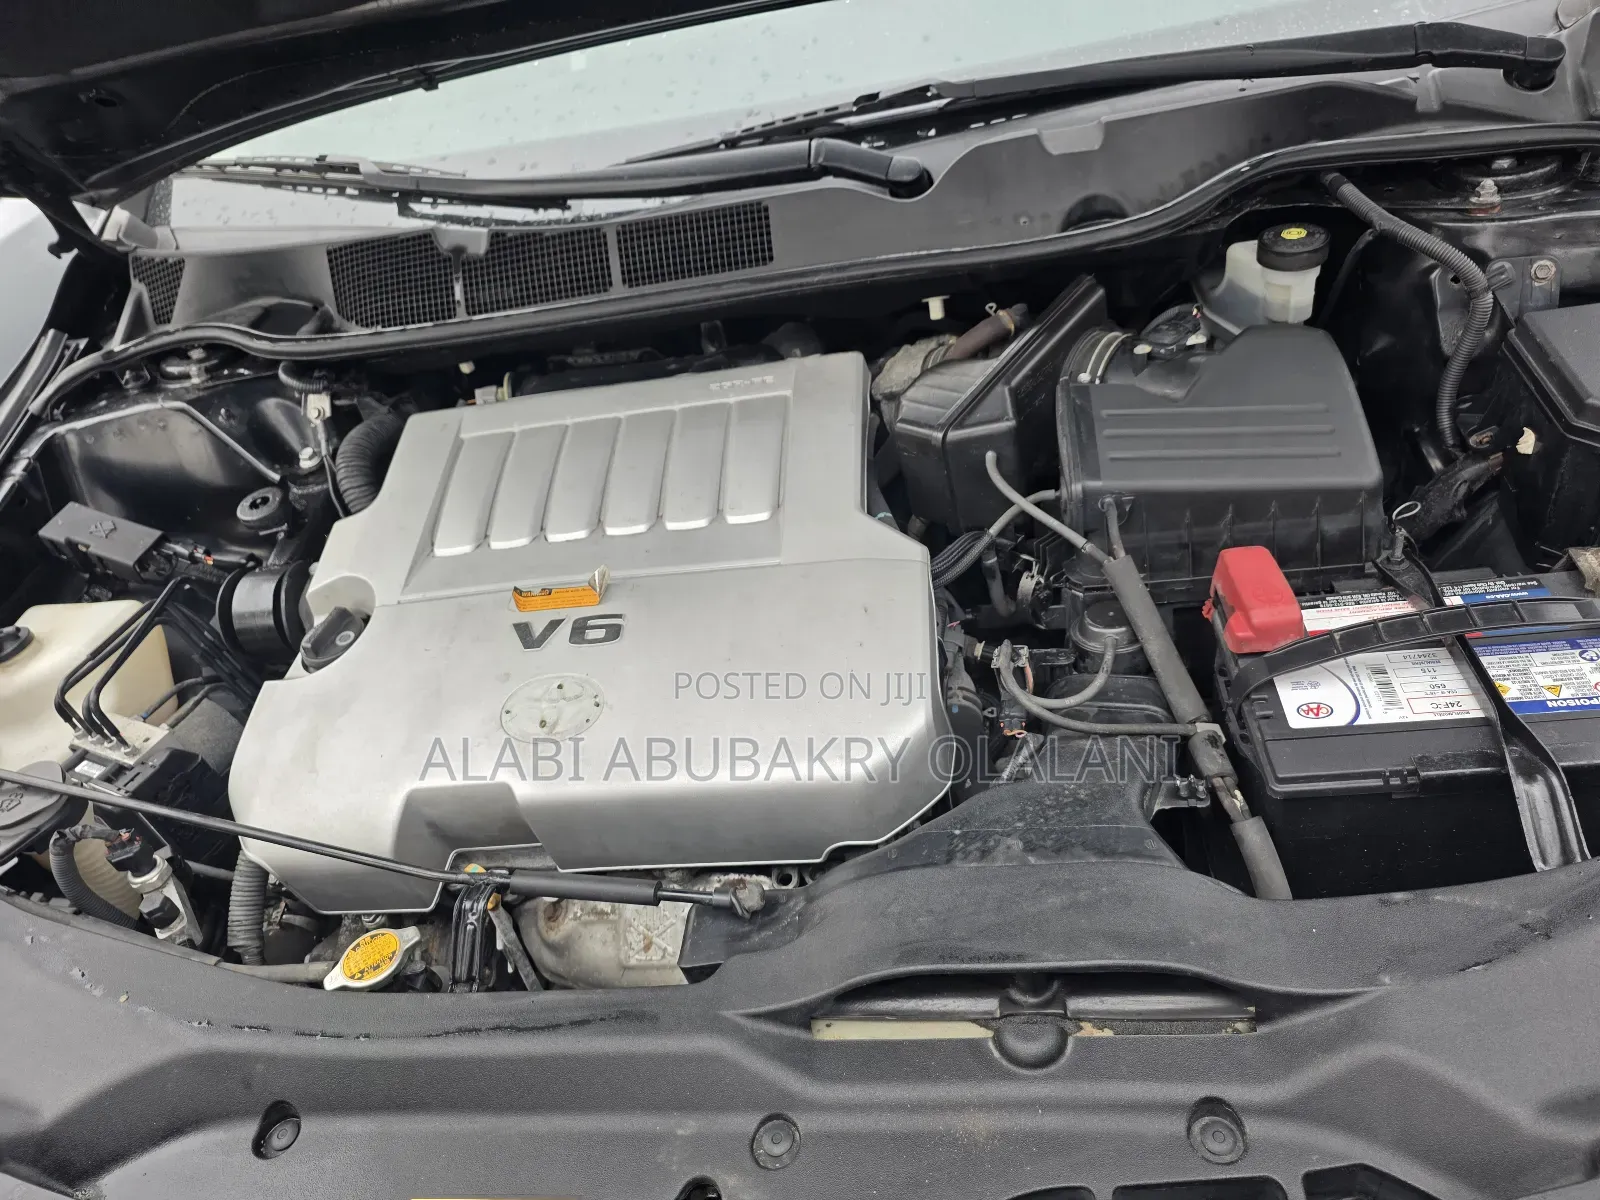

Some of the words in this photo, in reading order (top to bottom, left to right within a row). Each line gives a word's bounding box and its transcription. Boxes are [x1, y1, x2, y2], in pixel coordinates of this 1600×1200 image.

[512, 613, 625, 650] V6
[1546, 698, 1600, 708] POISON
[1301, 704, 1331, 717] CAA
